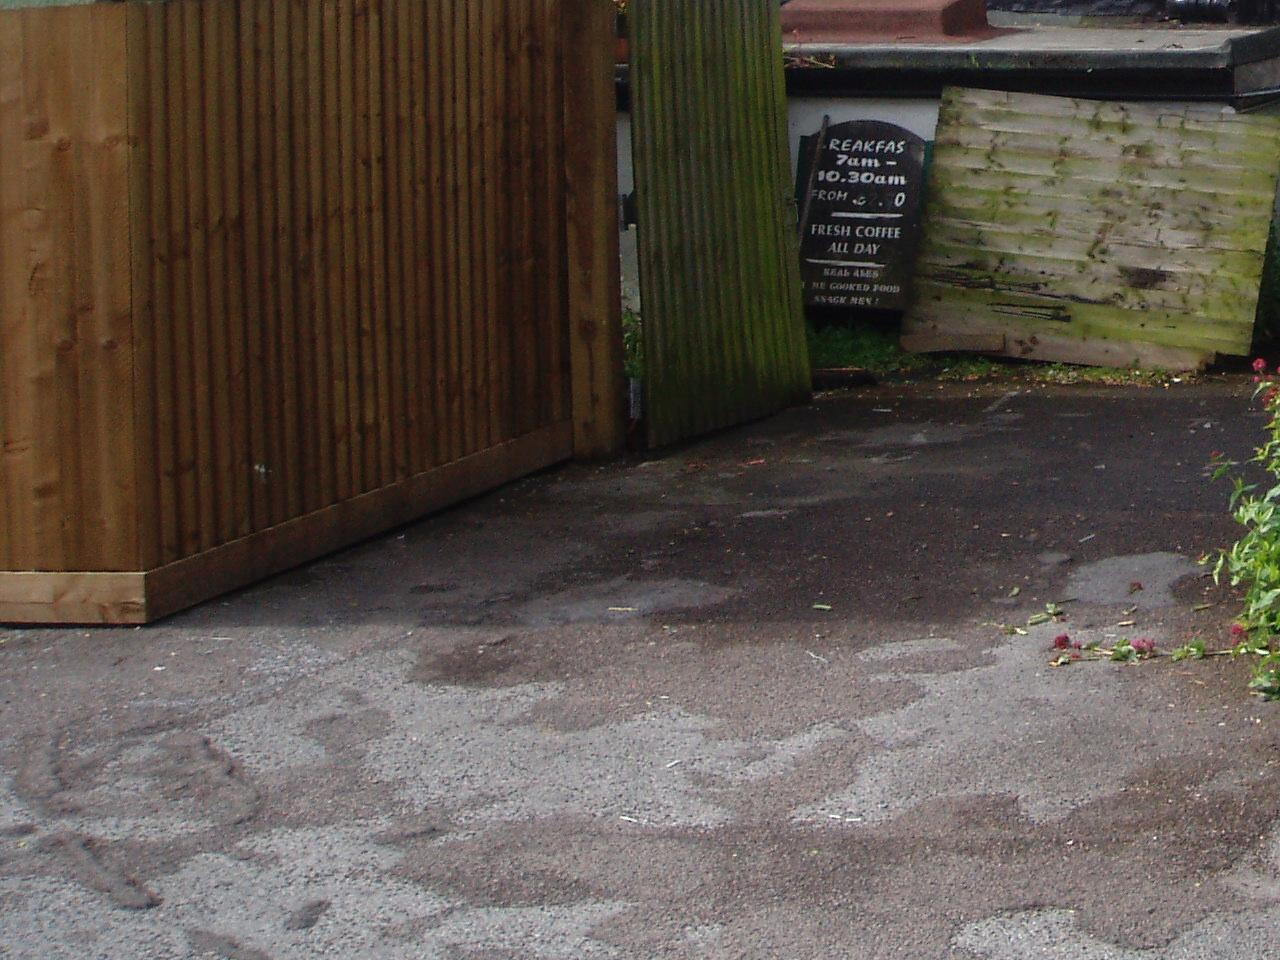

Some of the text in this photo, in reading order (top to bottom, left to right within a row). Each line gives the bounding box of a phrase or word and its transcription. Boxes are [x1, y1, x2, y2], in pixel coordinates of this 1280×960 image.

[836, 154, 881, 168] 7am
[817, 170, 907, 186] 10.30am
[811, 223, 902, 239] FRESH COFFEE
[827, 241, 881, 255] ALL DAY
[829, 281, 871, 292] COOKED
[872, 283, 900, 294] FOOD
